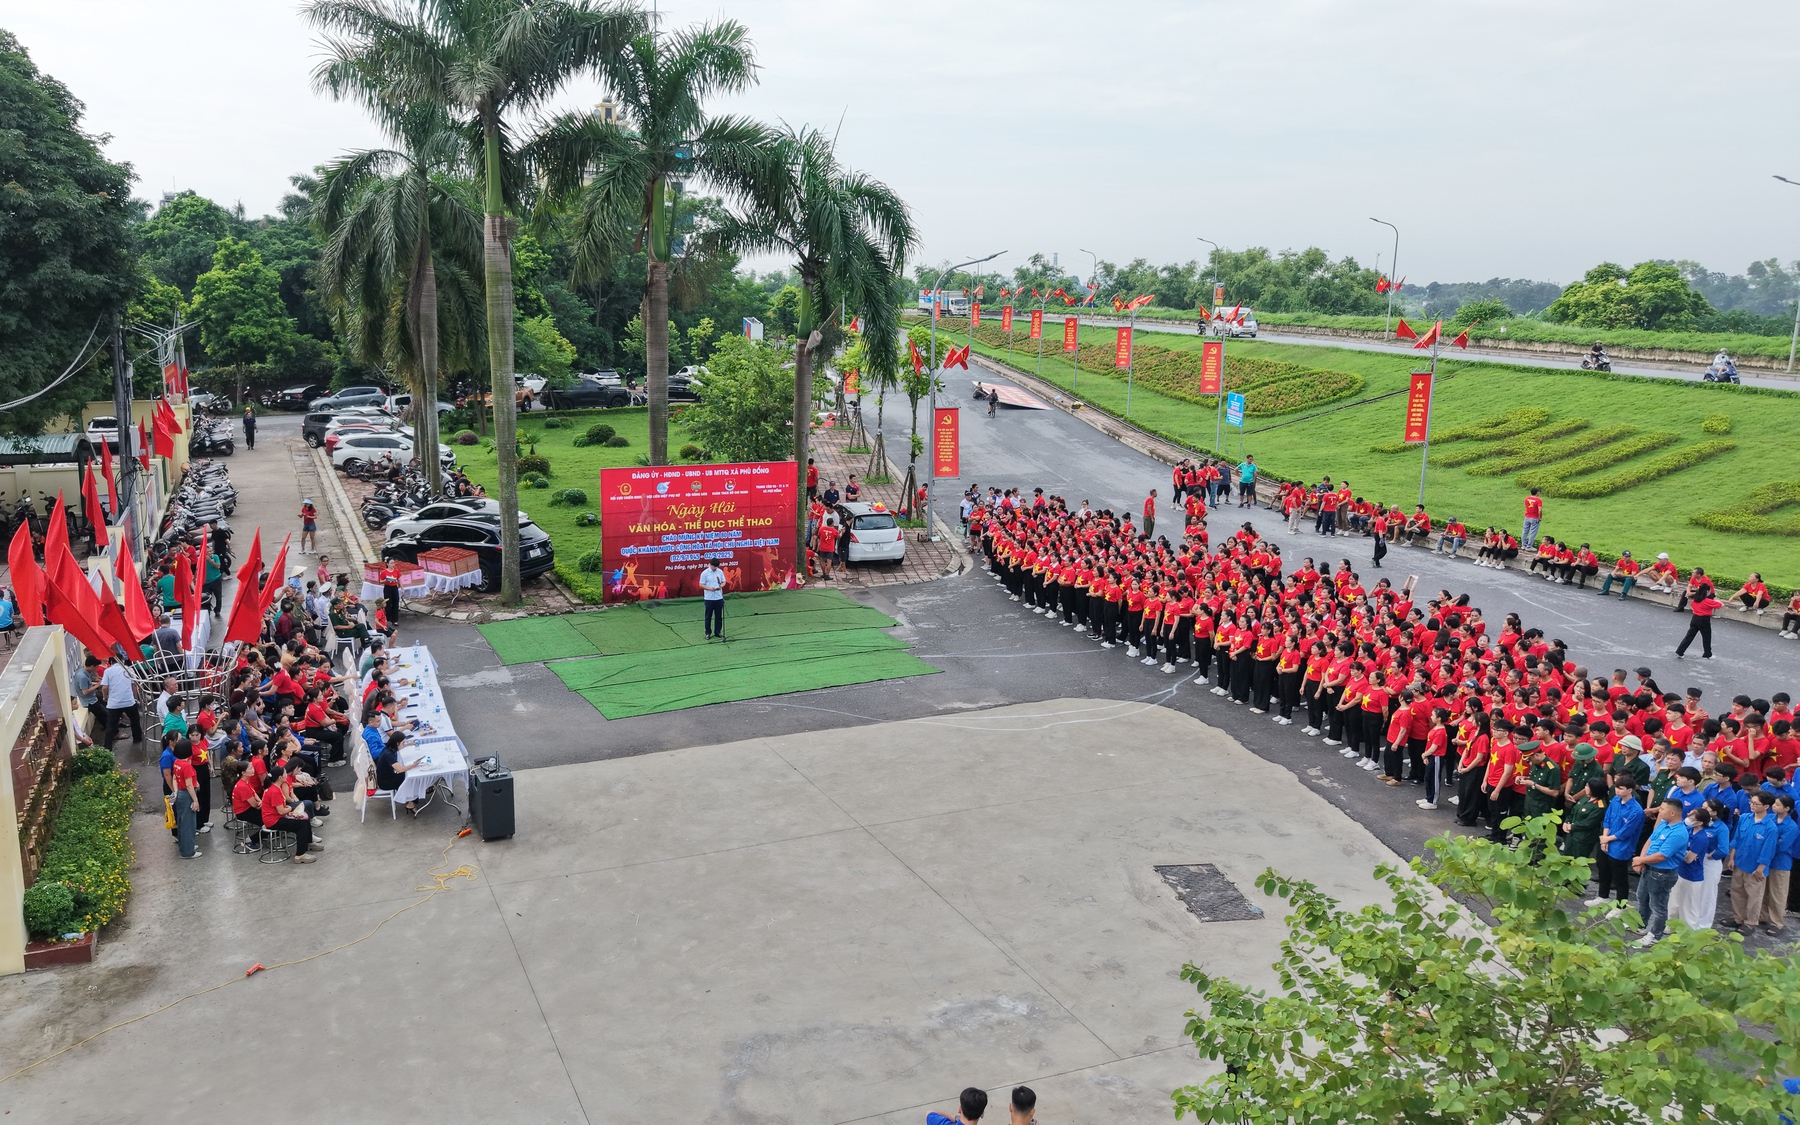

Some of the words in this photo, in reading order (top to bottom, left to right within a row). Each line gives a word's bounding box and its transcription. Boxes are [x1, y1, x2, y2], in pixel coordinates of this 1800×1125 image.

[667, 503, 707, 518] Ngày
[710, 501, 736, 515] Hội
[629, 522, 651, 533] VĂN
[654, 521, 677, 532] HÓA
[684, 517, 702, 530] THỂ
[704, 520, 725, 530] DỤC
[727, 515, 745, 528] THỂ
[746, 517, 773, 527] THAO
